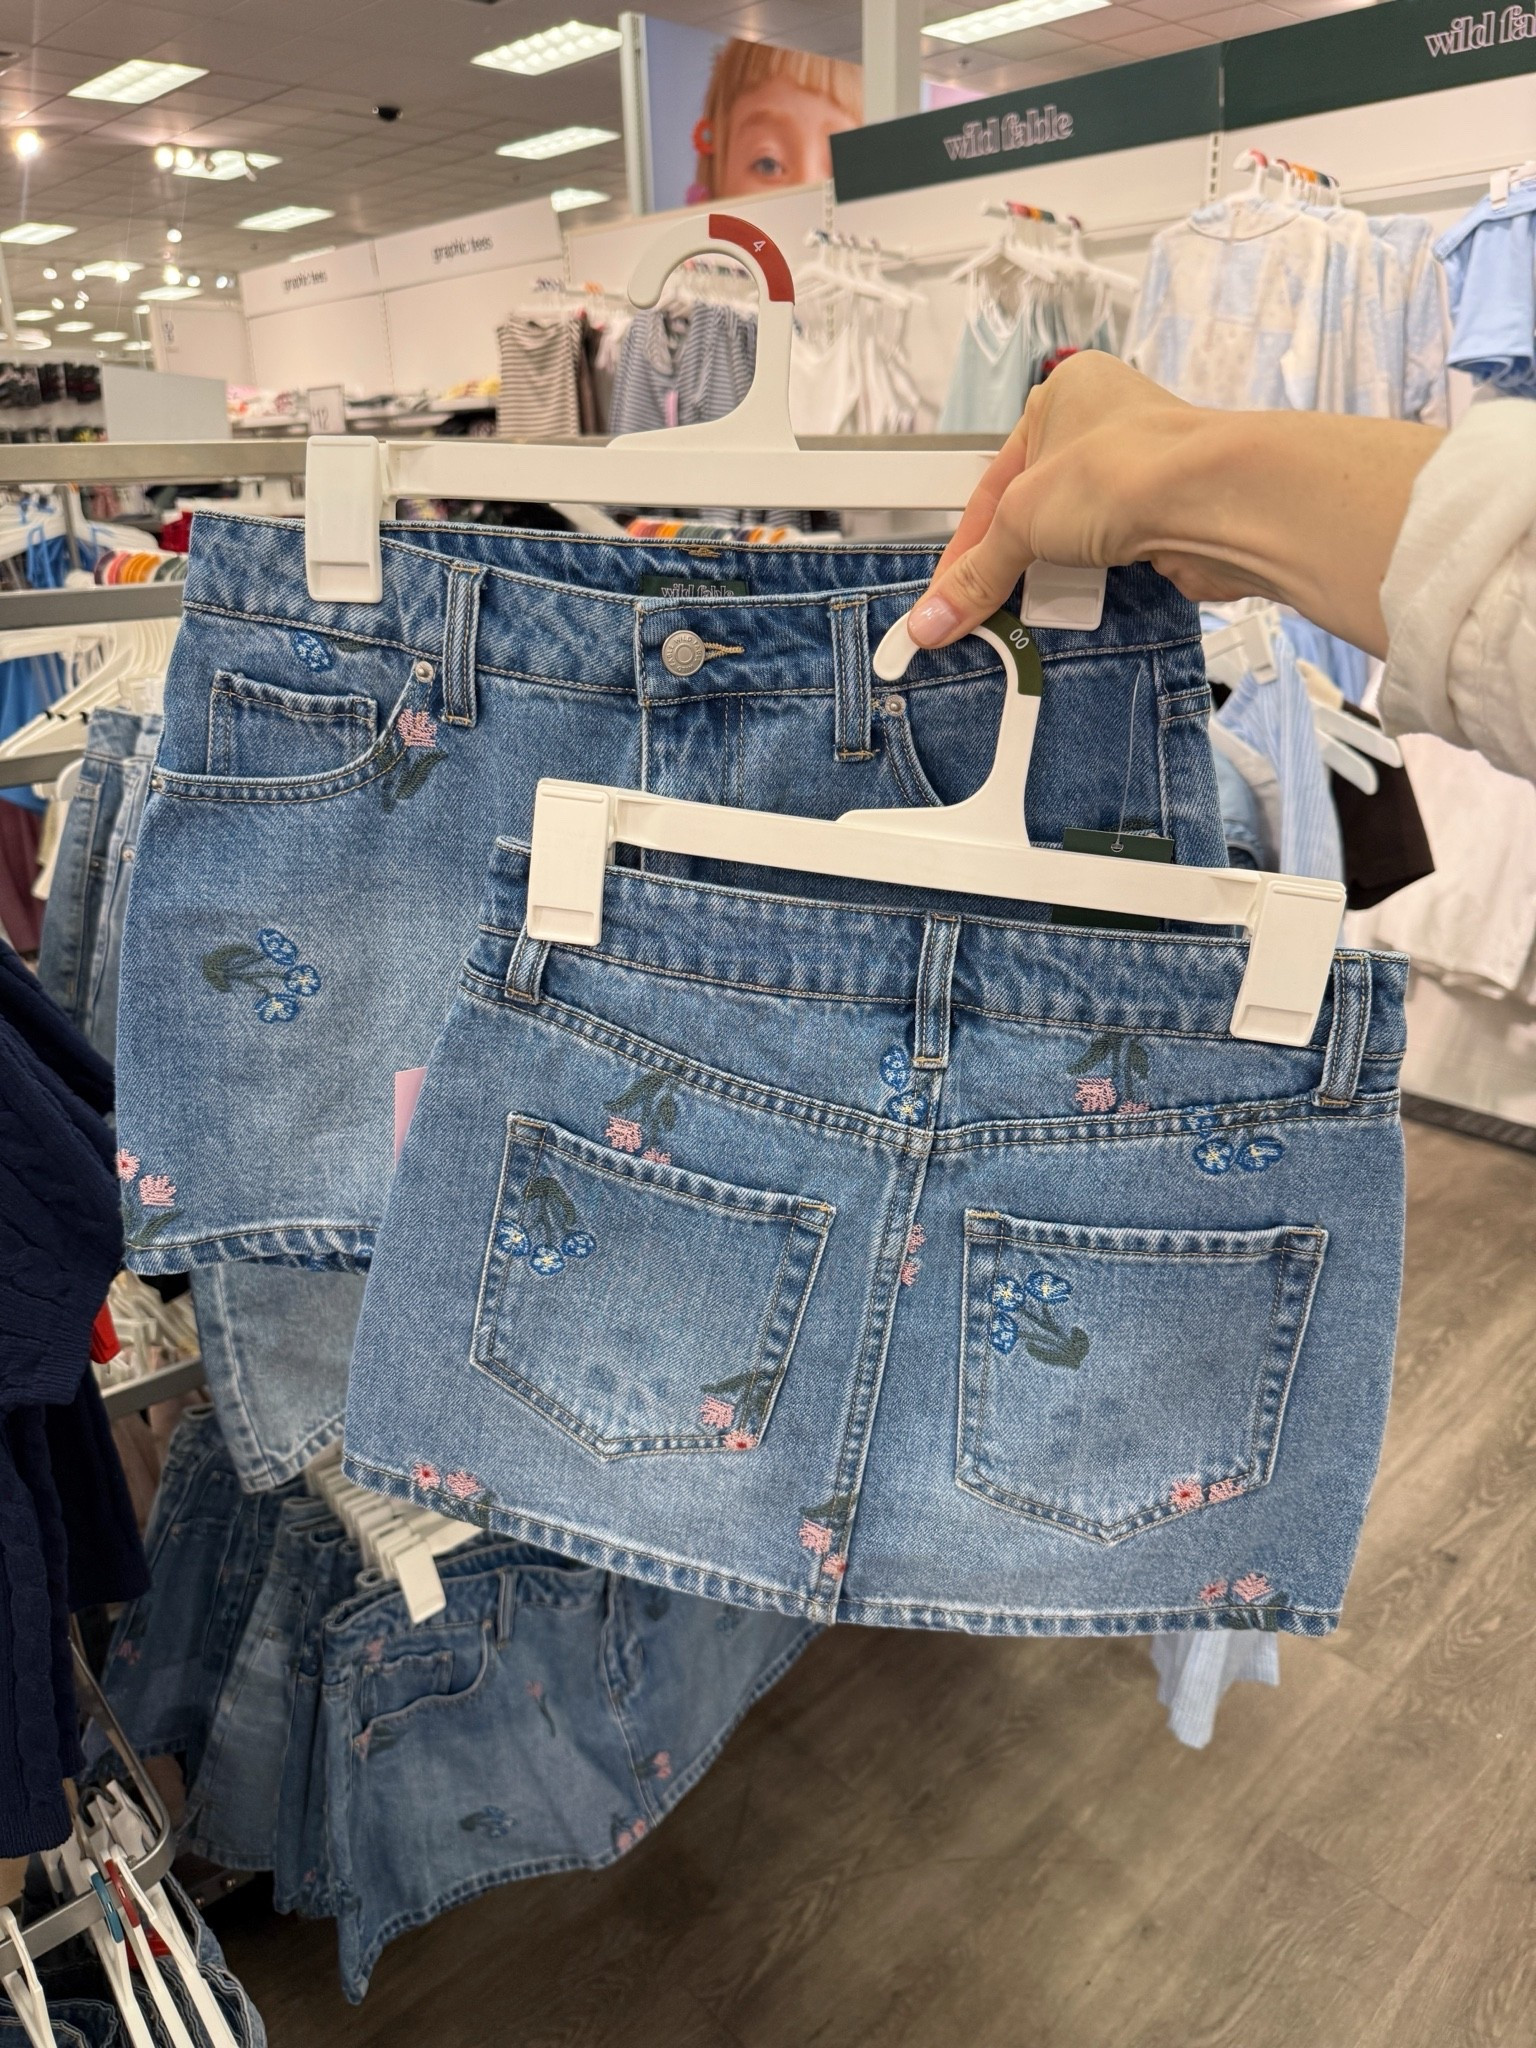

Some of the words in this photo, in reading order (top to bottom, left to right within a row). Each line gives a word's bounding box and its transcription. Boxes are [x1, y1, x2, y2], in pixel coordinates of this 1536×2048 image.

[1424, 10, 1496, 58] wild
[1498, 5, 1536, 44] fa
[943, 116, 1000, 161] wild
[1001, 104, 1074, 151] fable
[752, 240, 767, 253] 4
[1009, 628, 1030, 650] 00
